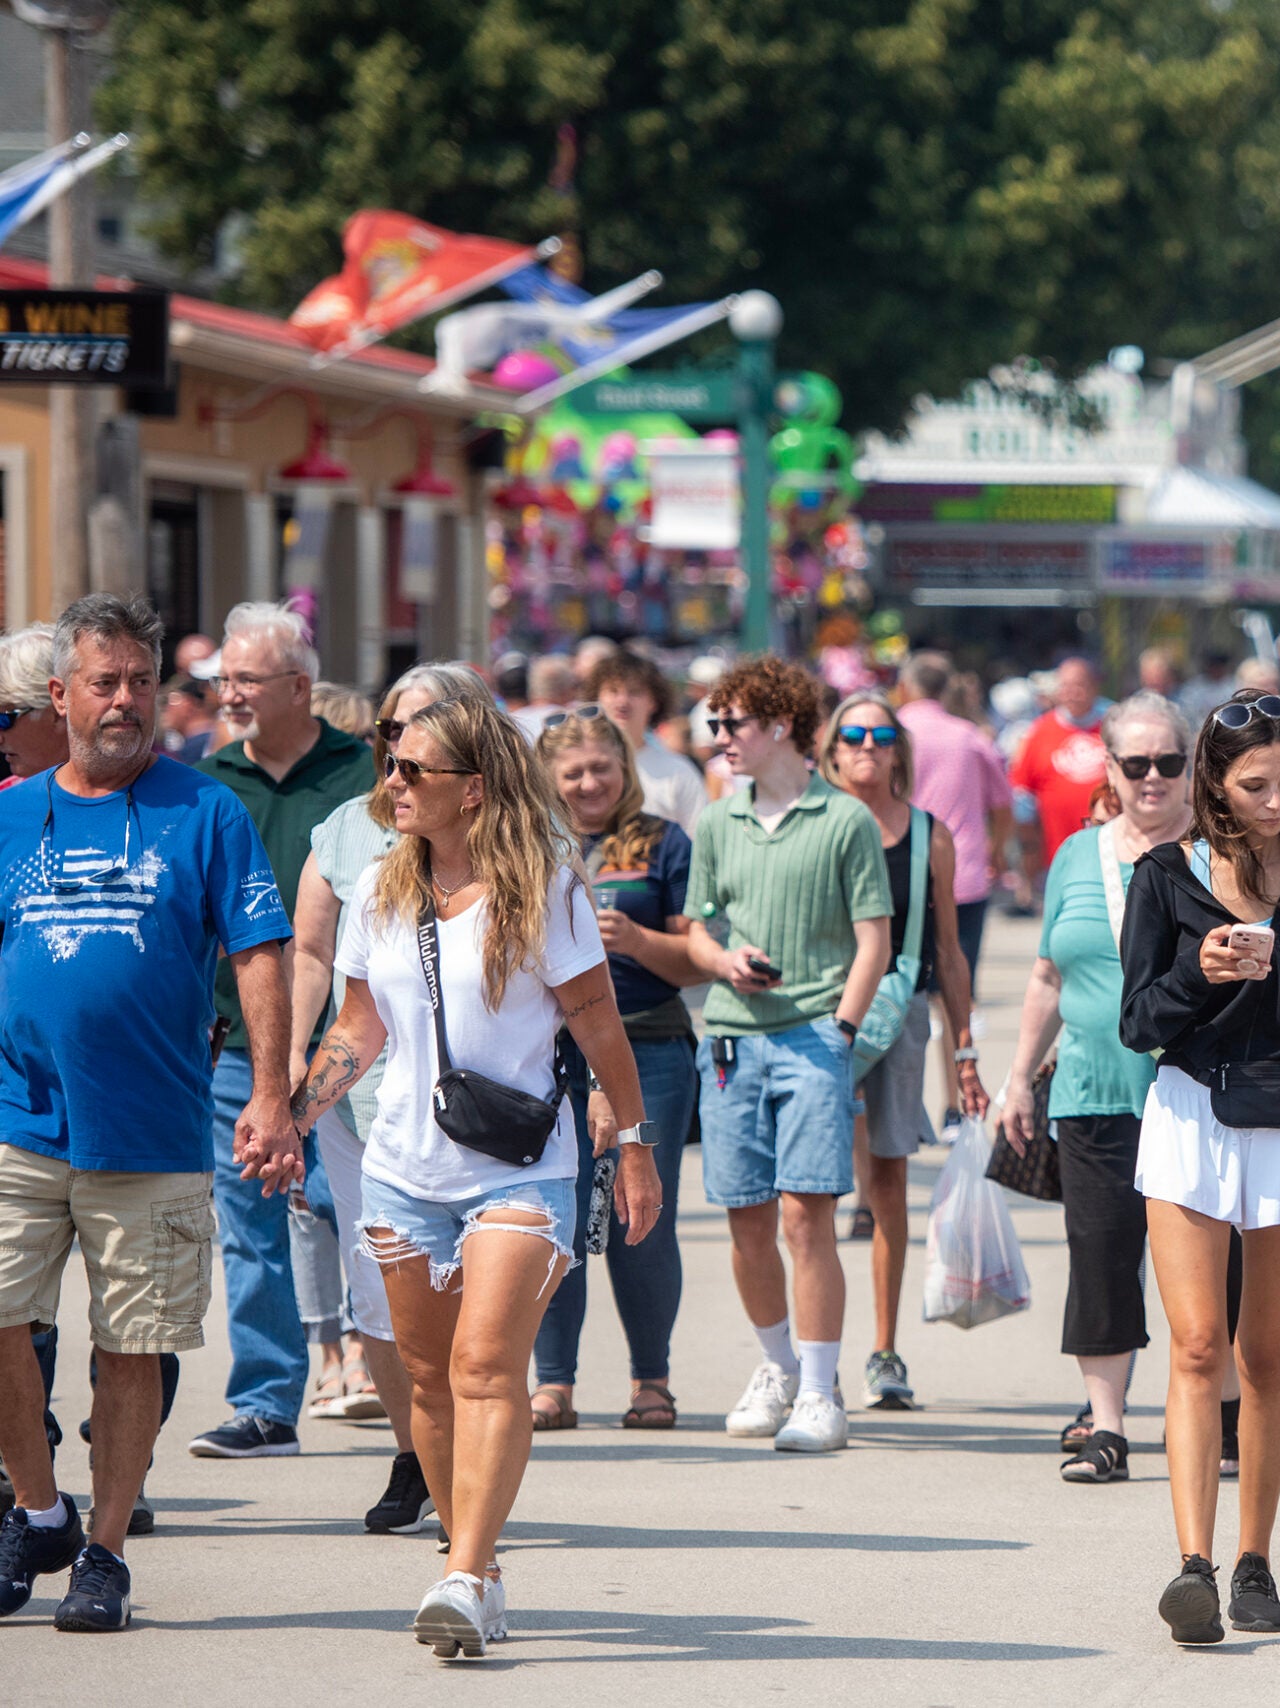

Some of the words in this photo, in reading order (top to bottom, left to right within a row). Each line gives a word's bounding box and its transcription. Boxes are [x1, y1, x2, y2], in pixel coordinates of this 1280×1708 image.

[23, 302, 130, 335] WINE
[1, 340, 130, 372] TICKETS
[418, 922, 439, 1010] lululemon
